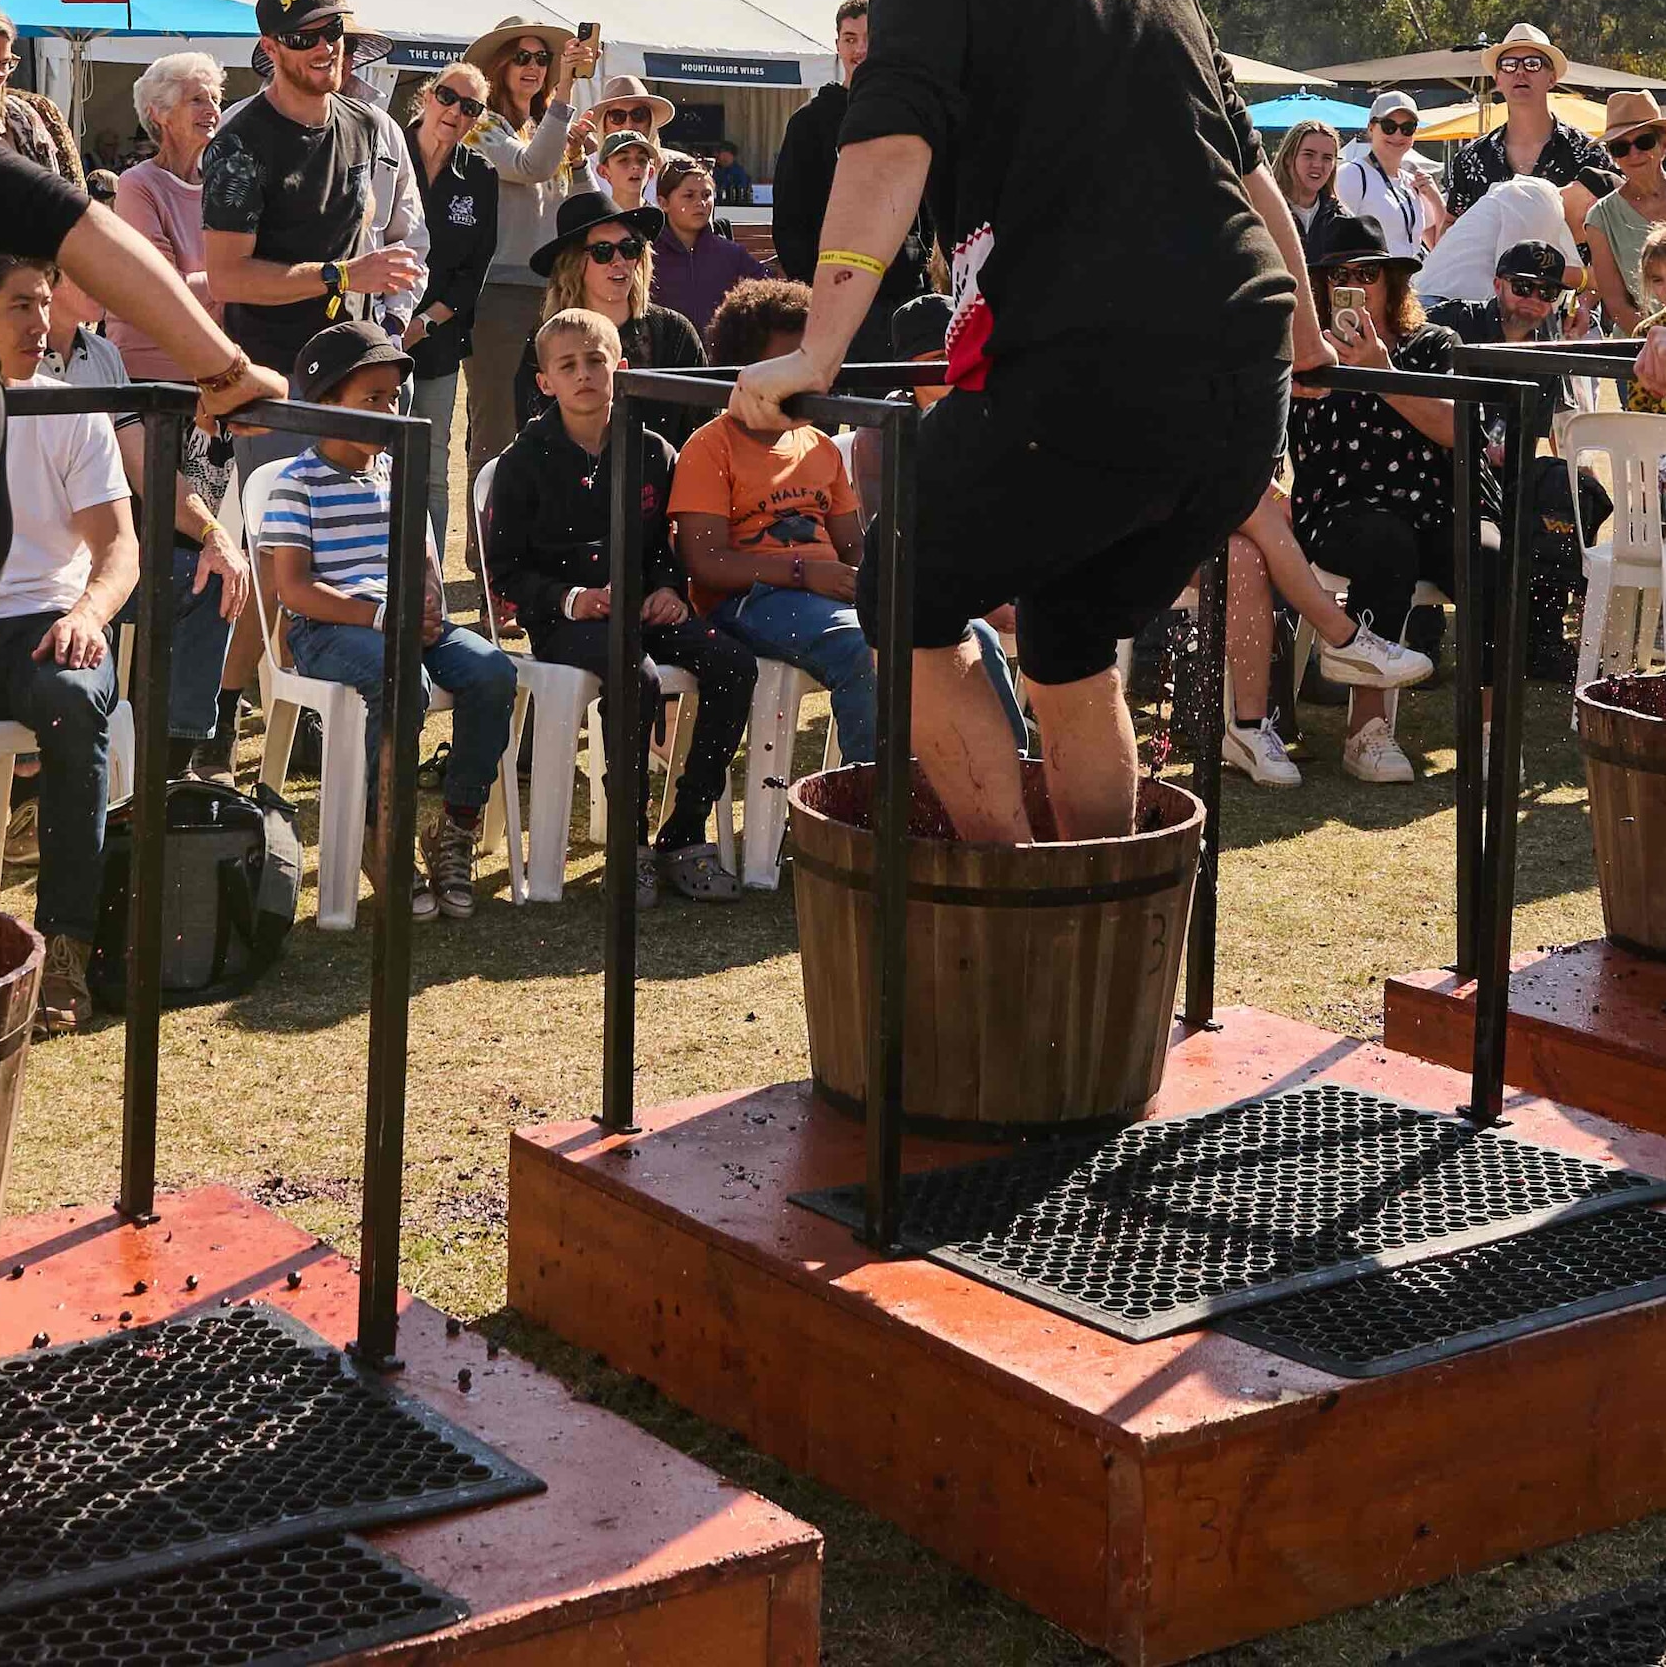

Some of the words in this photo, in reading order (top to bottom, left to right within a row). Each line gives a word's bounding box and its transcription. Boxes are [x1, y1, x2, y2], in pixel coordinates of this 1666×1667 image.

[408, 49, 429, 60] THE
[681, 63, 738, 75] MOUNTAINSIDE
[740, 66, 765, 76] WINES
